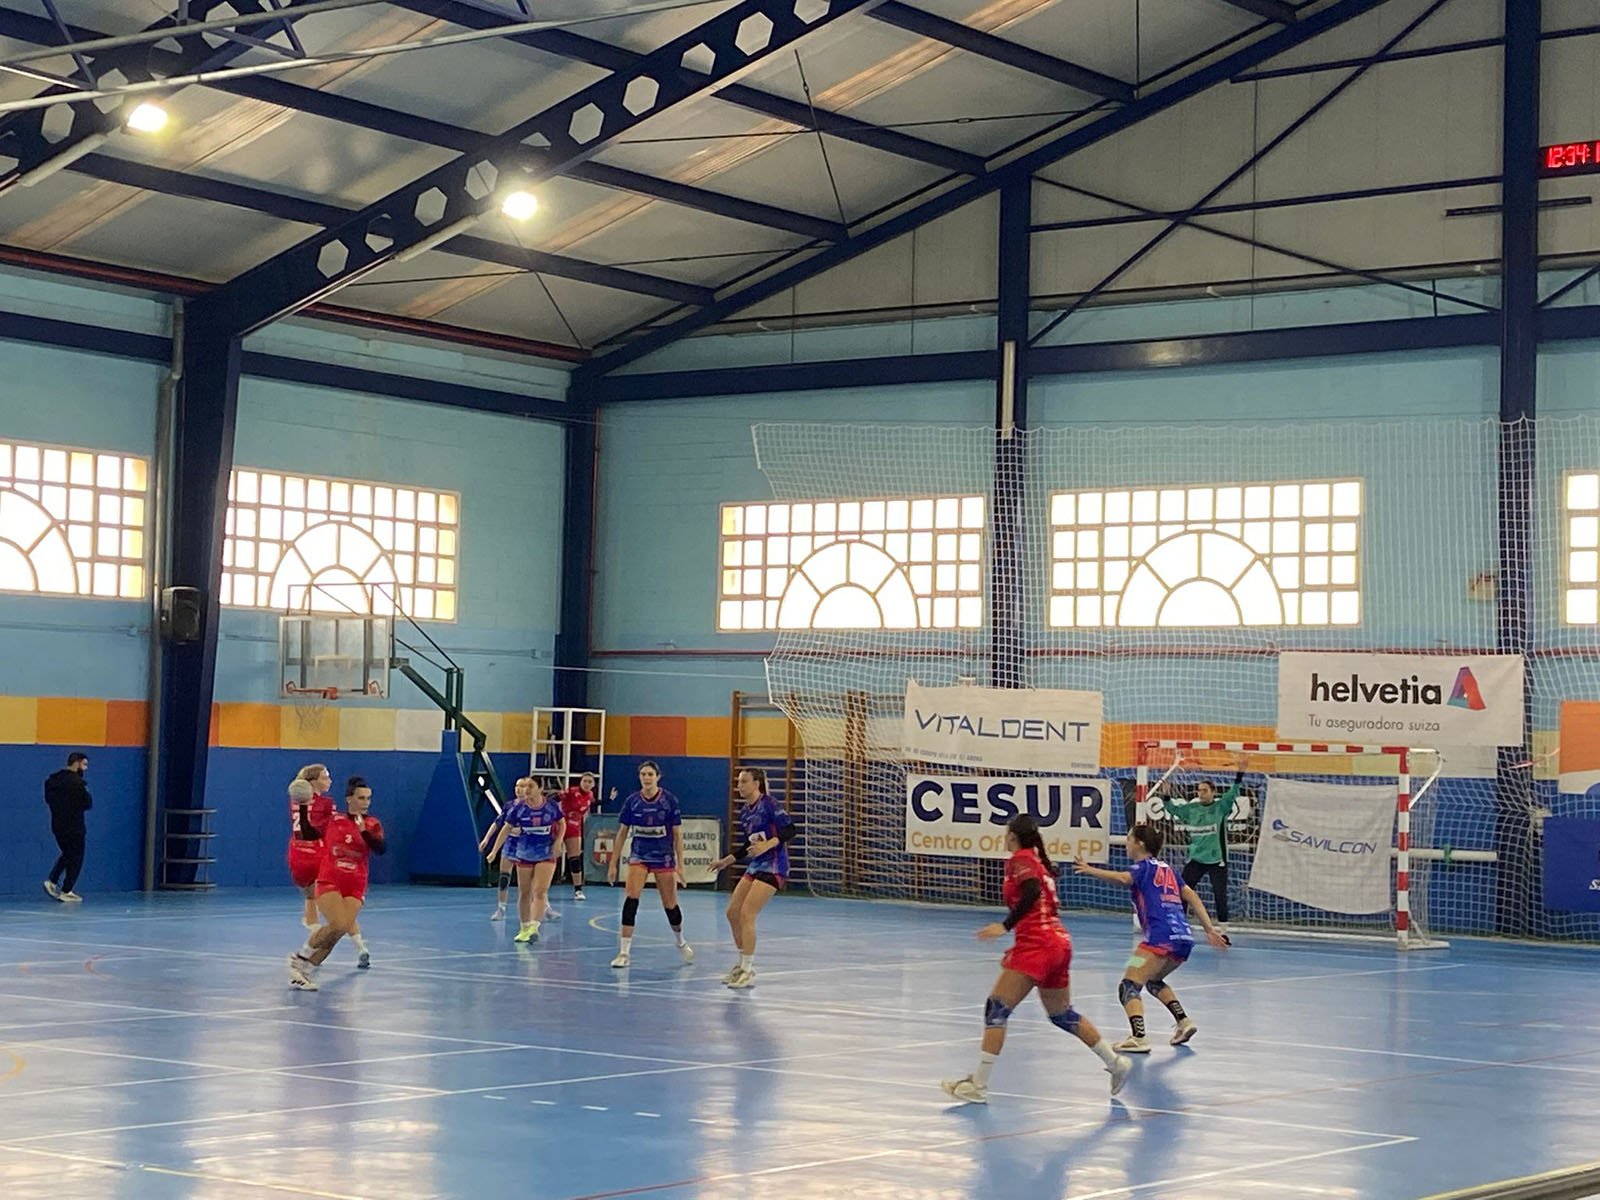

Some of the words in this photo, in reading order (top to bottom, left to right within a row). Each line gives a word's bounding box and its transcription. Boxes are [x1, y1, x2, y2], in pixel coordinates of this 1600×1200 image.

[1310, 673, 1442, 705] helvetia
[915, 709, 1090, 742] VITALDENT
[1308, 714, 1322, 728] Tu
[1326, 715, 1404, 732] aseguradora
[1408, 720, 1440, 732] suiza
[911, 780, 1103, 829] CESUR
[911, 831, 973, 851] Centro
[1050, 837, 1071, 856] de
[1077, 839, 1103, 857] FP
[1289, 831, 1377, 854] SAVILCON
